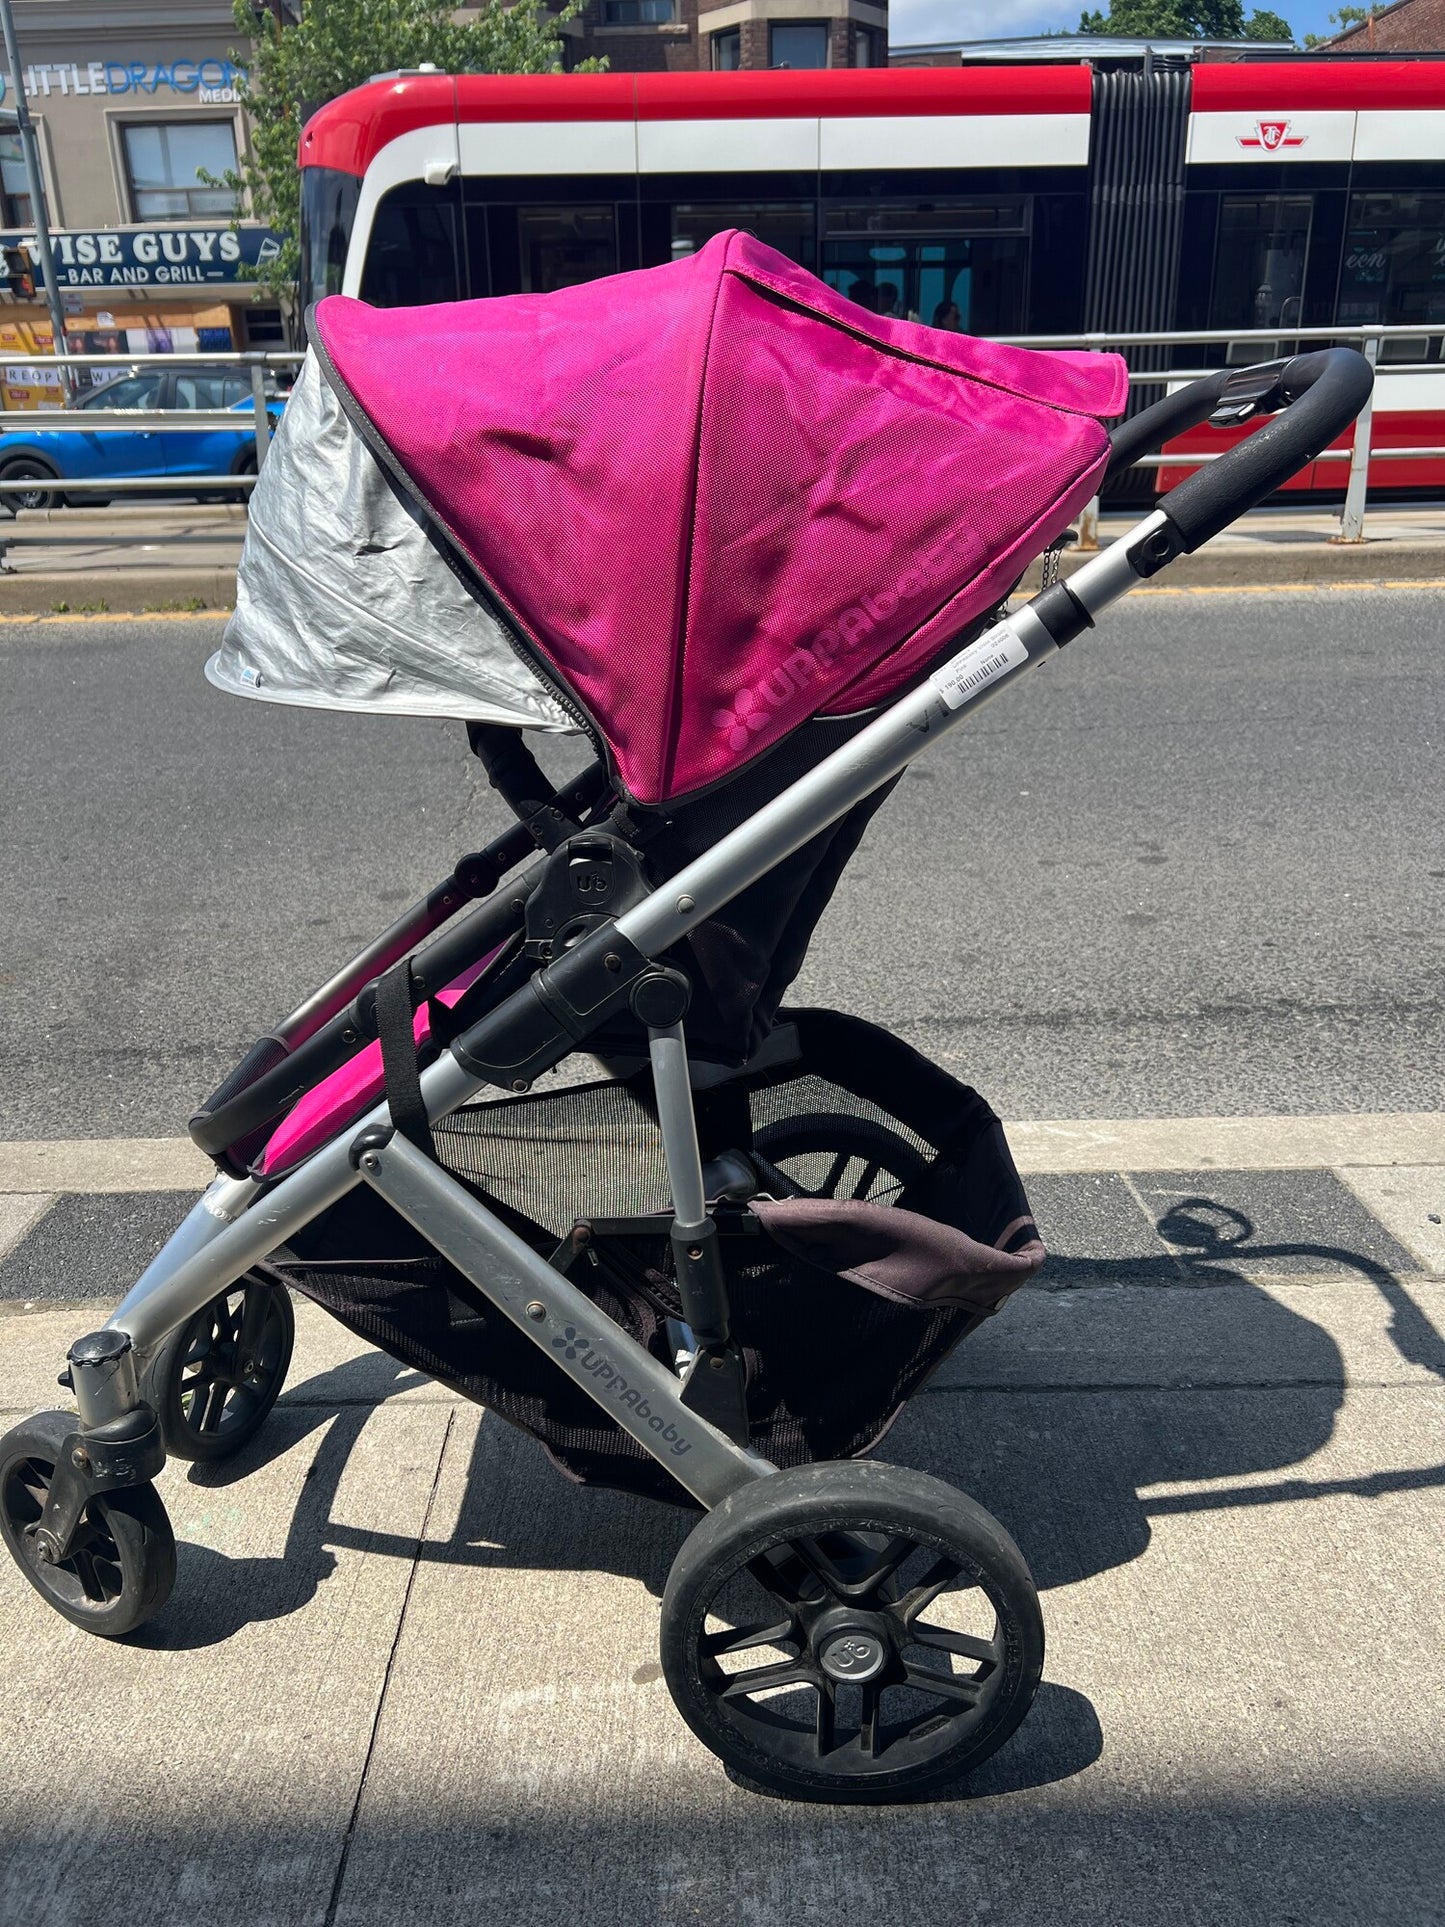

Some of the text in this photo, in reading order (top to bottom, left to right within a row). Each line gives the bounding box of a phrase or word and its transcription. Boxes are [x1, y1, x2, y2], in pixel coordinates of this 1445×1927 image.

[24, 57, 248, 97] ITTLEDRAGON
[132, 231, 241, 263] GUYS
[68, 265, 204, 284] BAR AND GRILL
